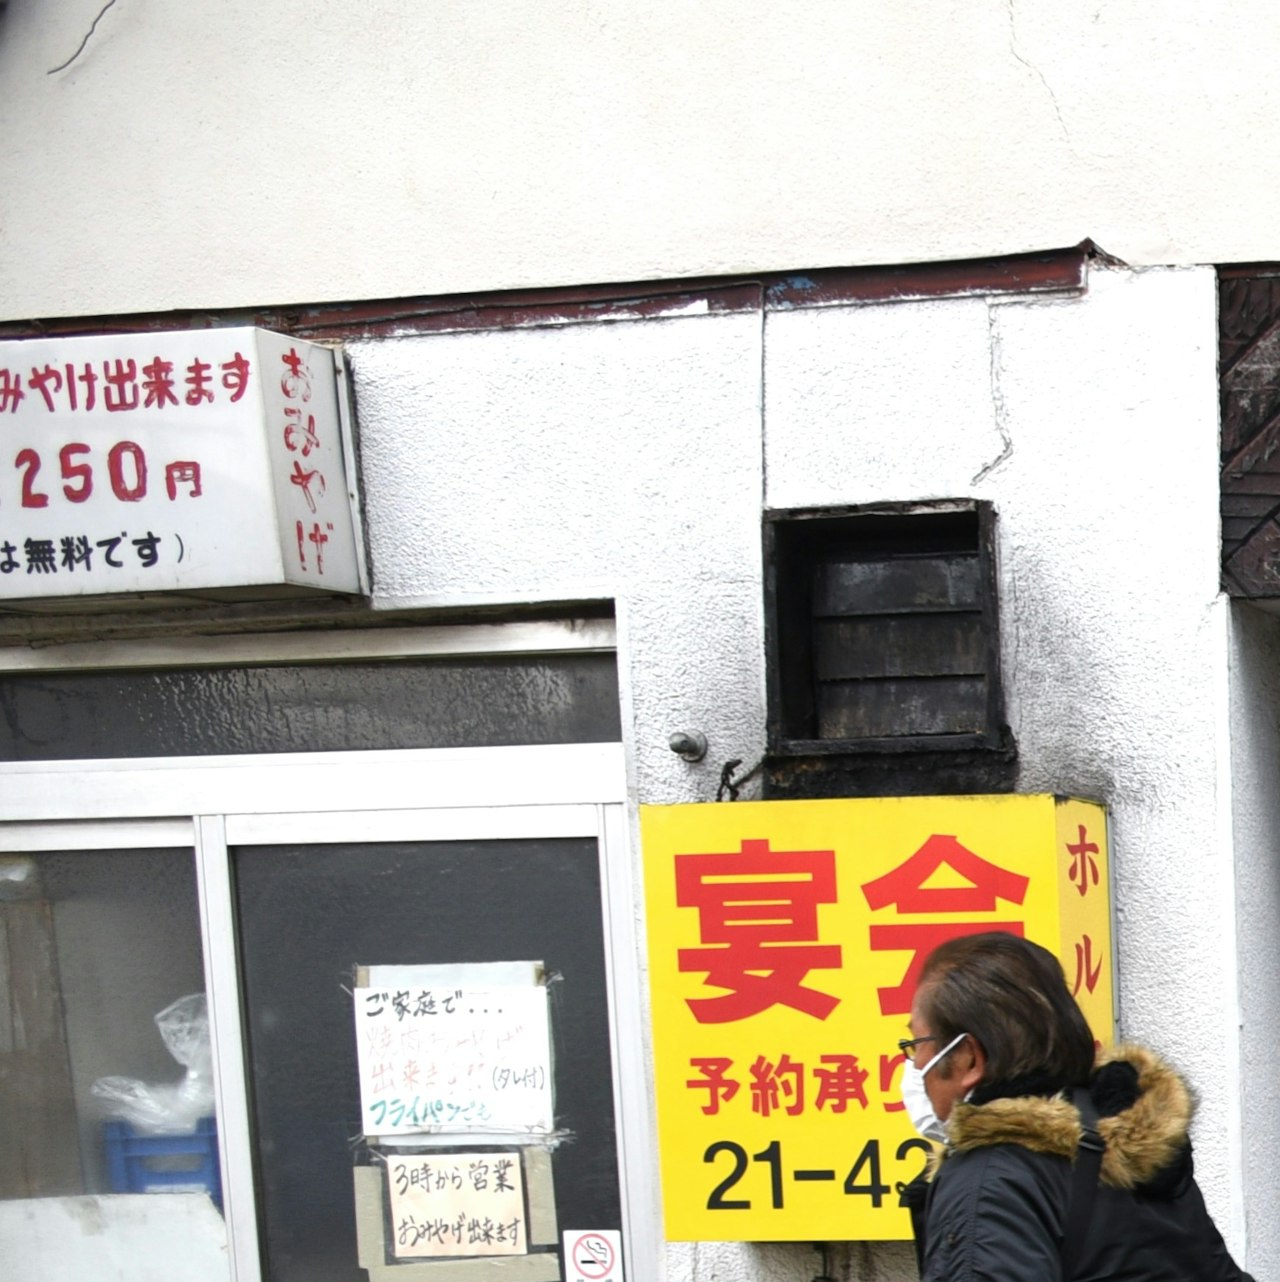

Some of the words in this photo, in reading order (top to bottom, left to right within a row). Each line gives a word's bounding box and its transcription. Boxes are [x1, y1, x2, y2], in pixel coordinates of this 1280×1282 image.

[15, 440, 203, 509] 250円
[281, 347, 334, 576] おみやげ
[673, 833, 1031, 1025] 宴会
[1065, 823, 1105, 1064] ホル
[394, 1159, 516, 1196] 3時から営業
[397, 1211, 522, 1248] おみやげ出来ます
